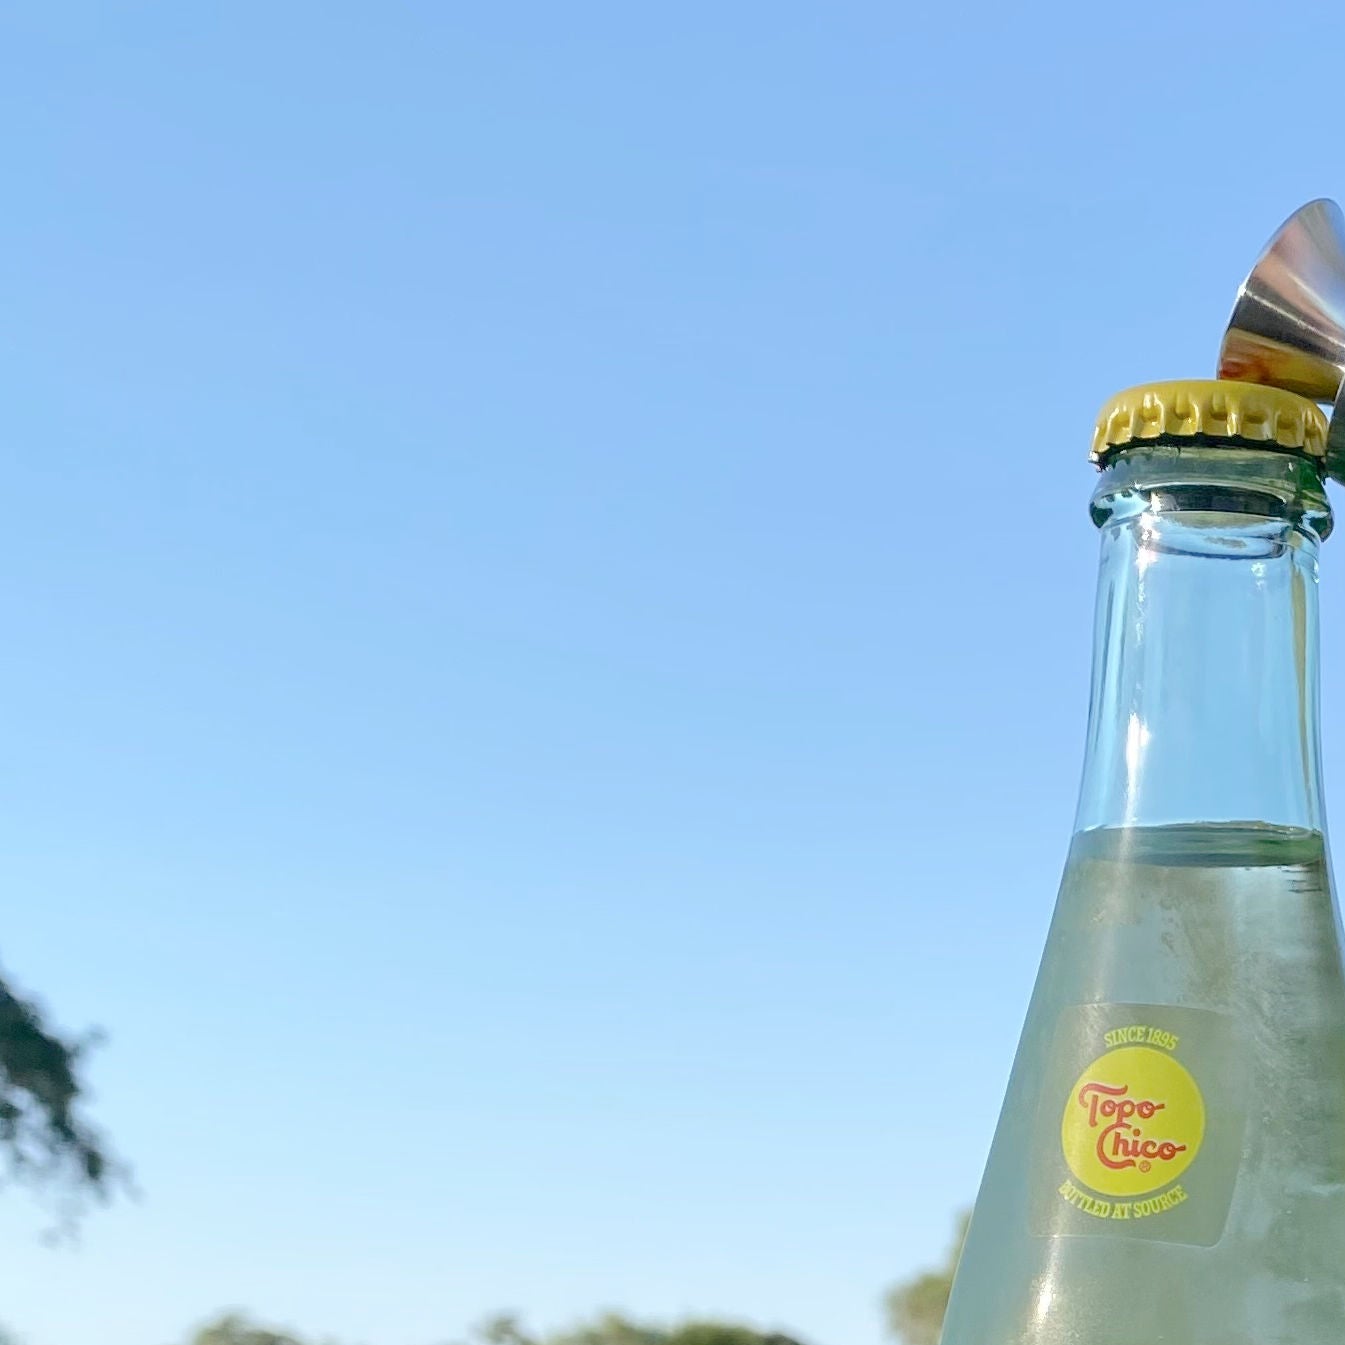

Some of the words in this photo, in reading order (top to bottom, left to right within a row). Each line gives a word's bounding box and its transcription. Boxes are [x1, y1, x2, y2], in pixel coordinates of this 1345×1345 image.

[1103, 1025, 1146, 1048] SINCE
[1148, 1028, 1179, 1050] 1895
[1078, 1082, 1166, 1128] Topo
[1096, 1122, 1187, 1170] Chico
[1111, 1202, 1132, 1219] AT
[1132, 1185, 1189, 1218] SOURCE
